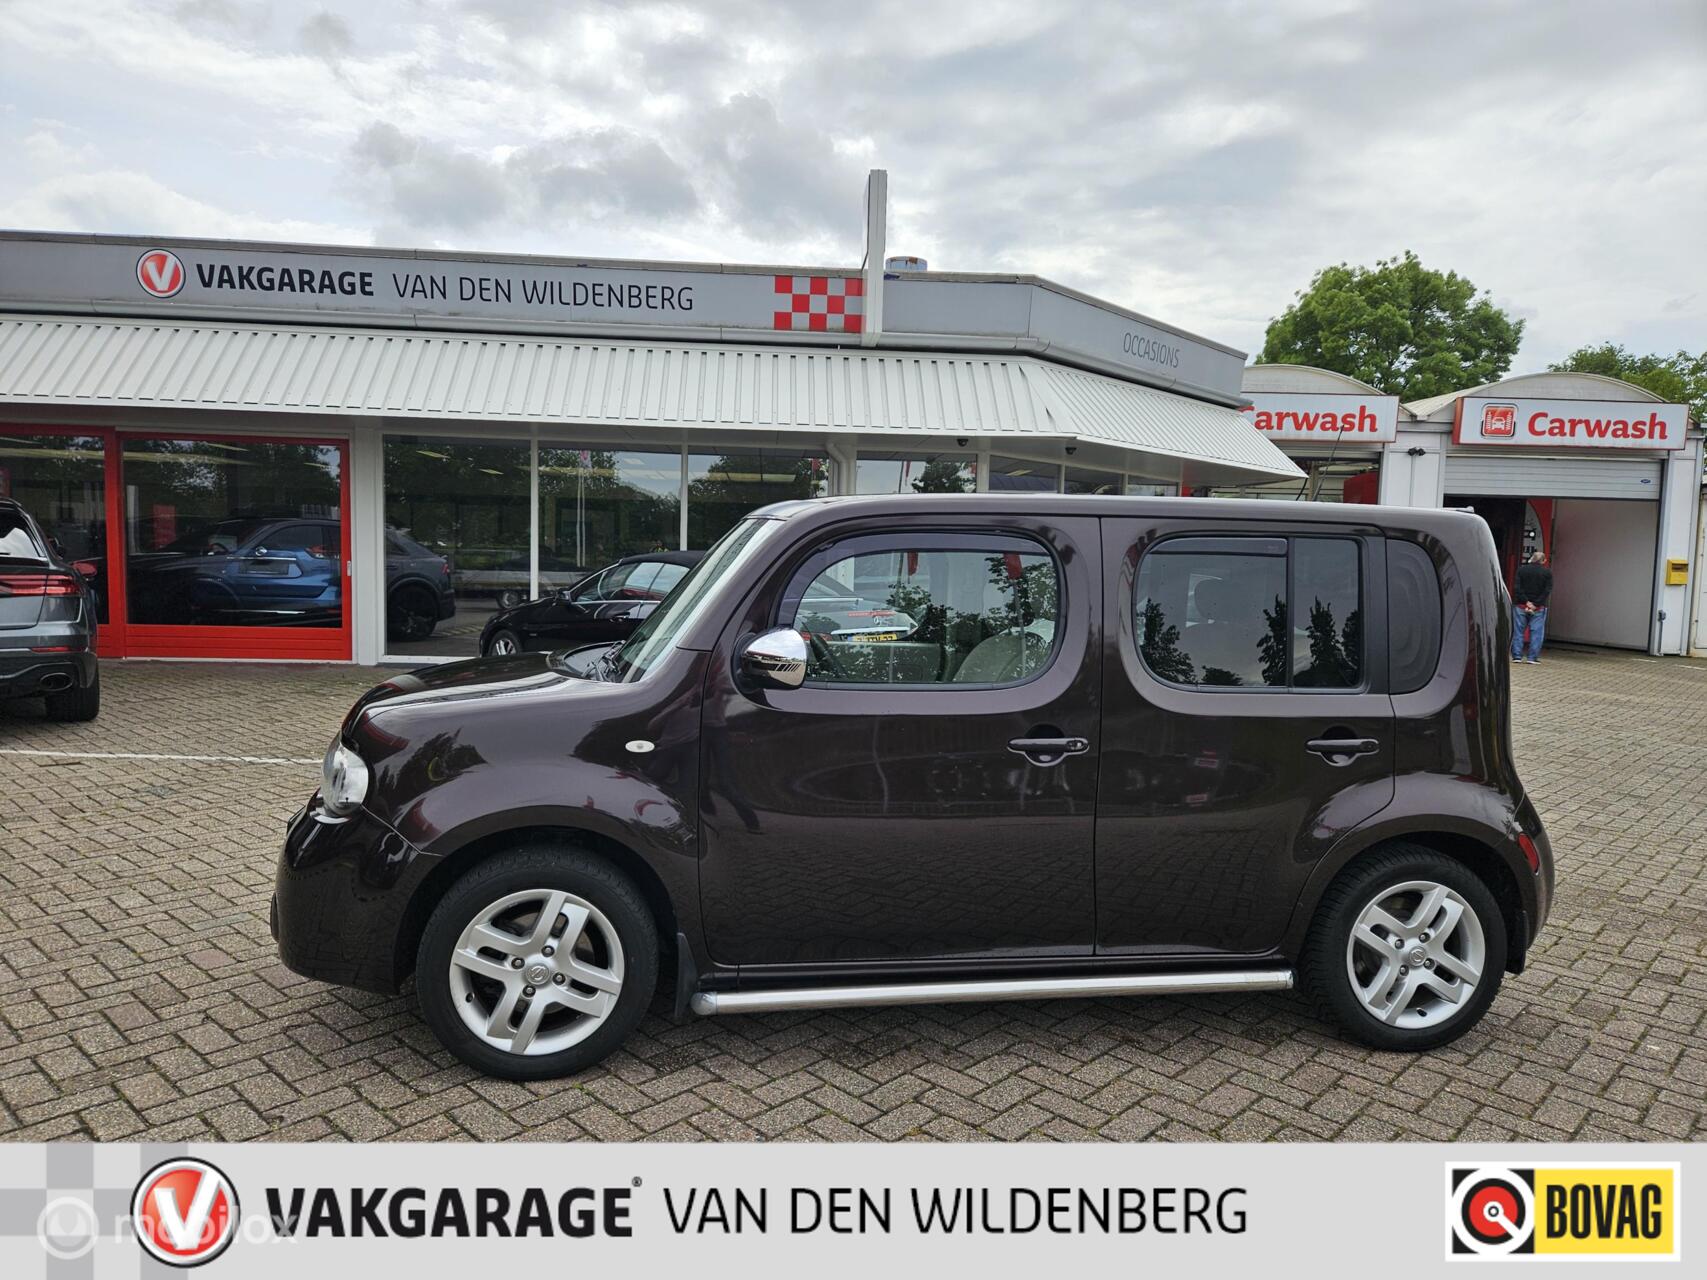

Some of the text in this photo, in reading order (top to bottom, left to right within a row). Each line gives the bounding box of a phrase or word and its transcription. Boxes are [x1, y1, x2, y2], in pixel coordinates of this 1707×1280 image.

[196, 263, 693, 311] VAKGARAGE VAN DEN WILDENBERG
[1123, 332, 1181, 368] OCCASIONS
[1528, 412, 1668, 439] Carwash
